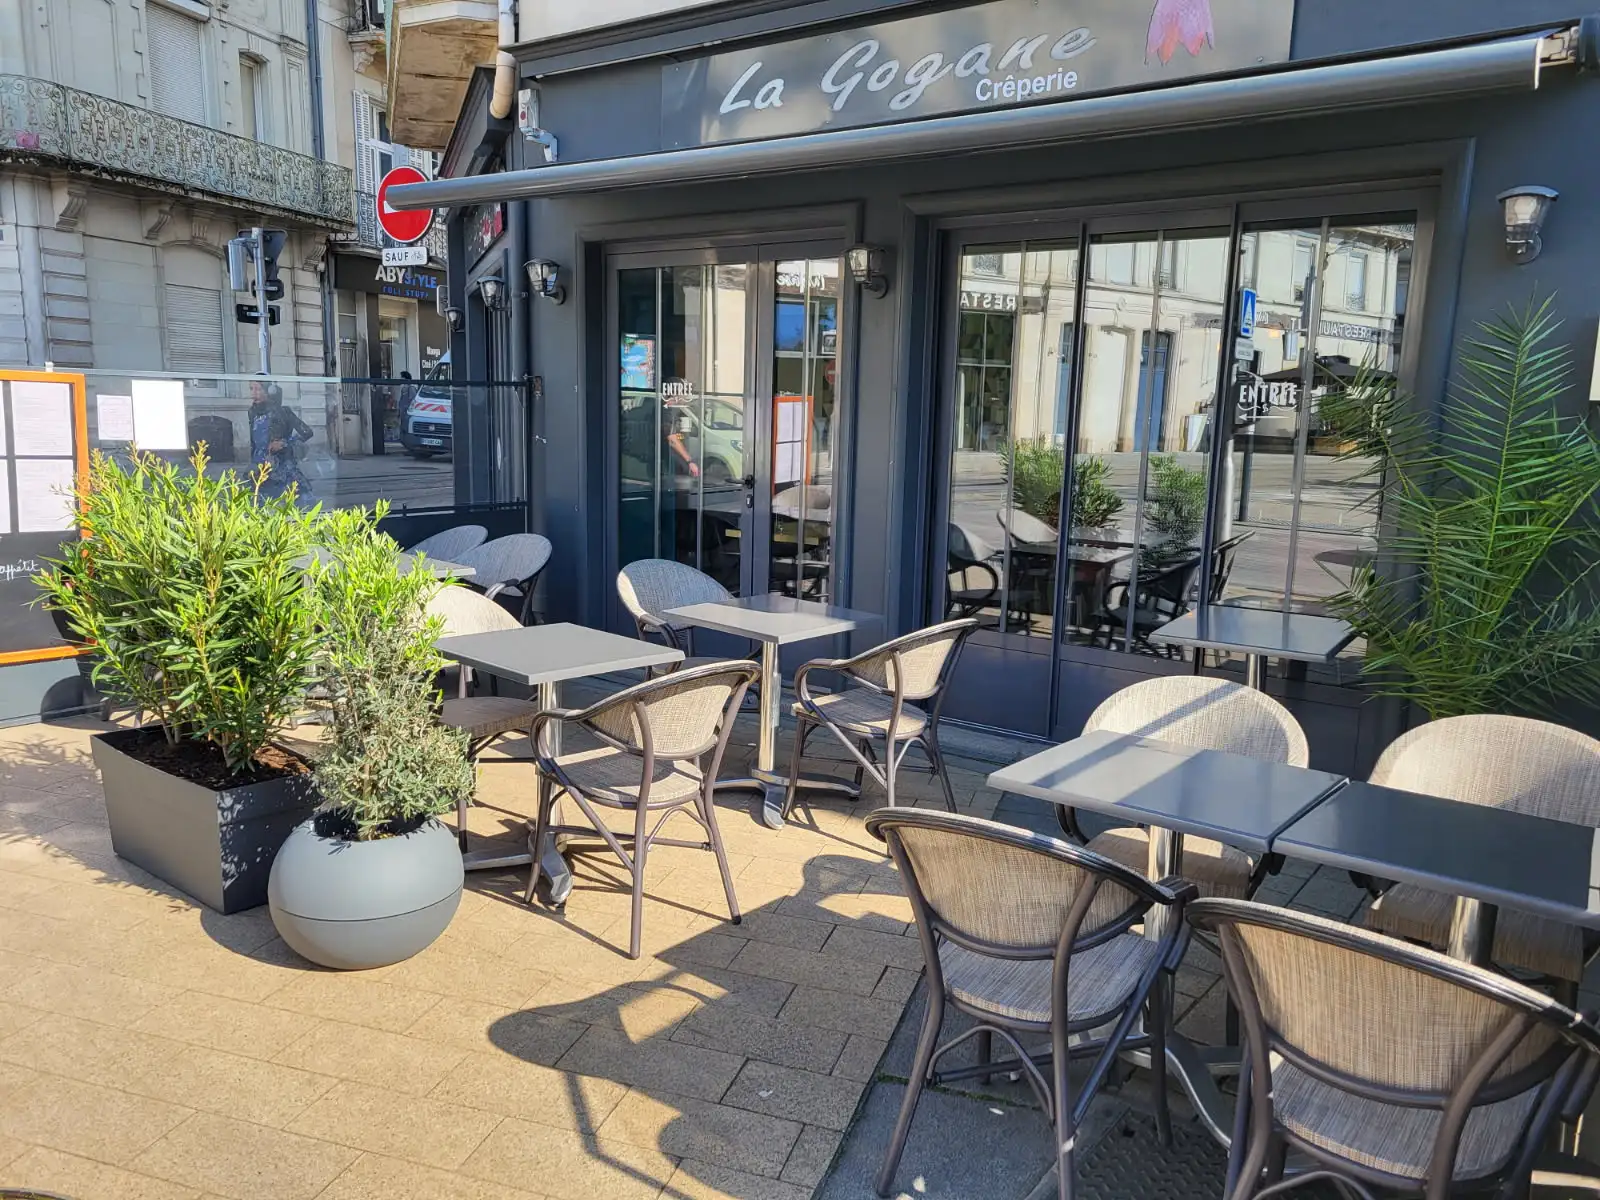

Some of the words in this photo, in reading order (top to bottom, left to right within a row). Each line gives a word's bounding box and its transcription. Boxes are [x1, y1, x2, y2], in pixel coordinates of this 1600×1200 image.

[719, 61, 785, 114] La
[819, 26, 1097, 112] Gogane
[975, 67, 1079, 103] Crêperie
[385, 252, 409, 262] SAUF
